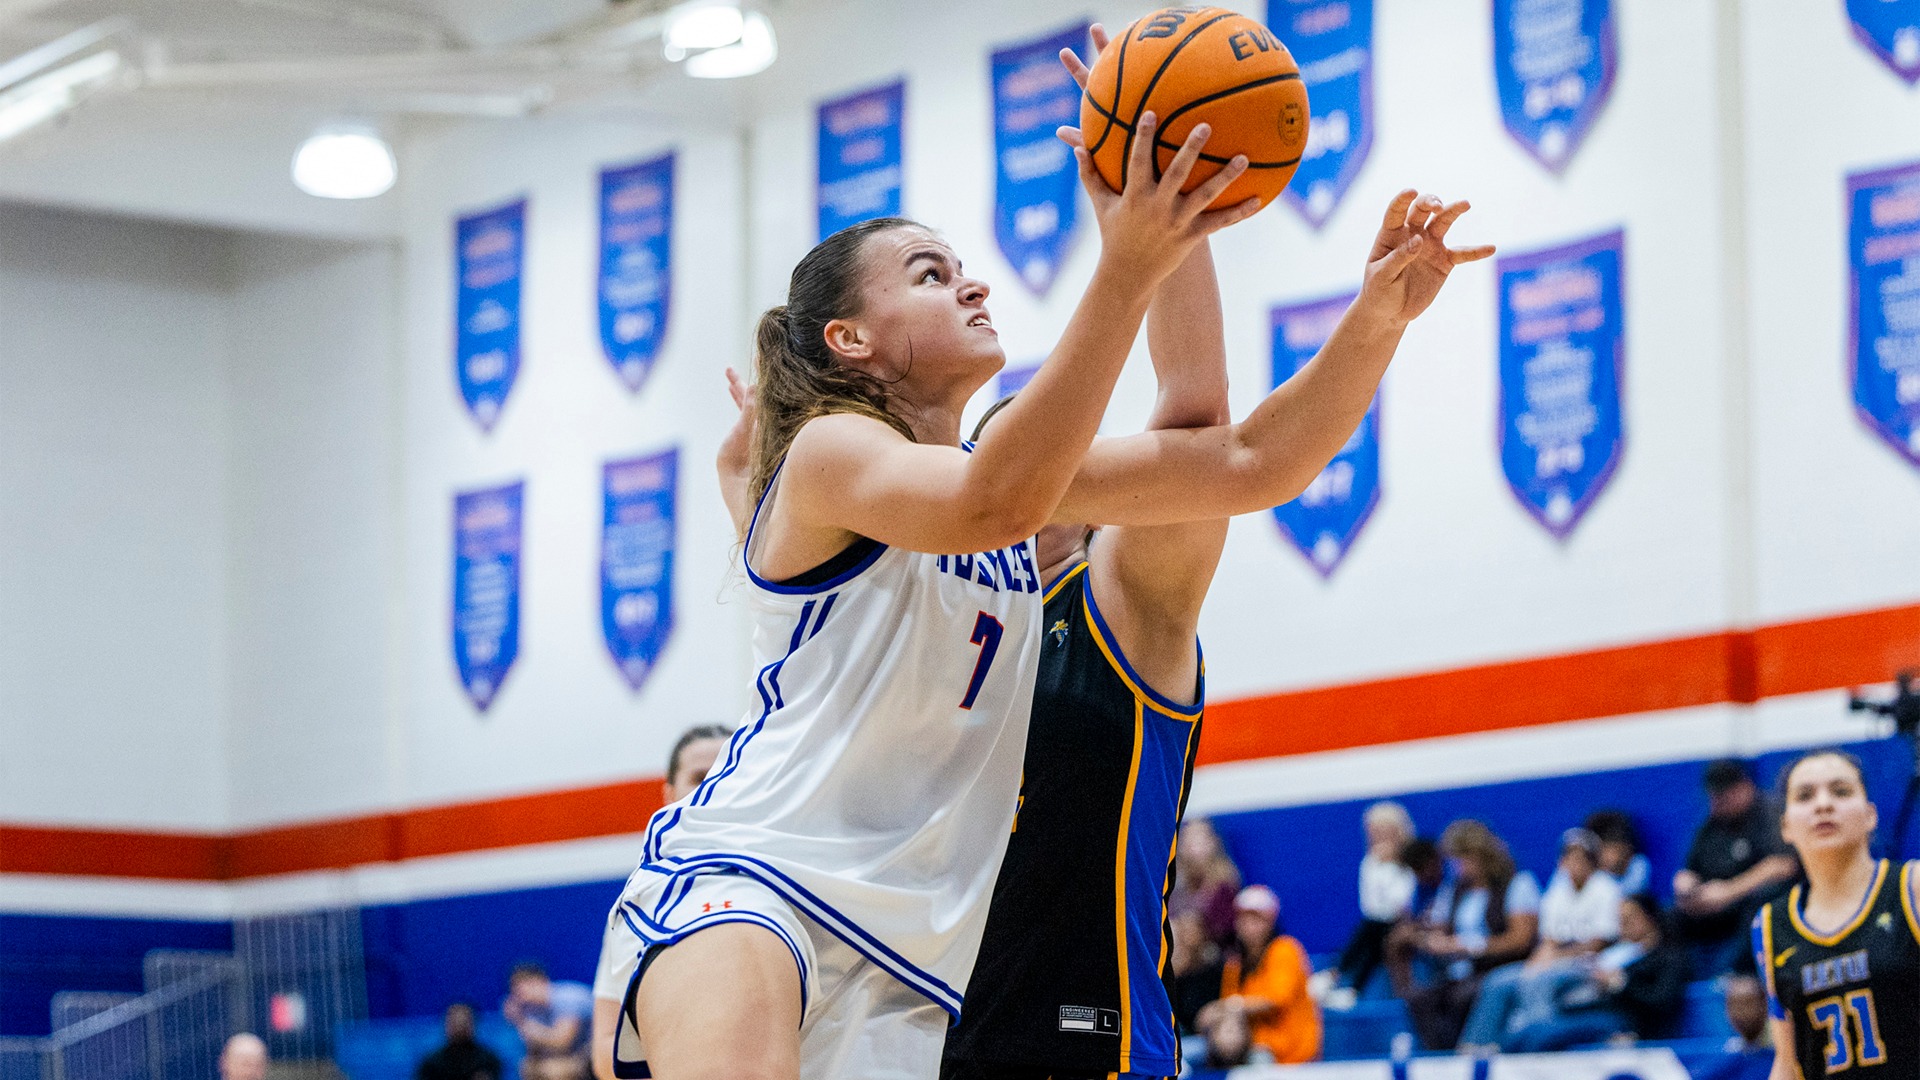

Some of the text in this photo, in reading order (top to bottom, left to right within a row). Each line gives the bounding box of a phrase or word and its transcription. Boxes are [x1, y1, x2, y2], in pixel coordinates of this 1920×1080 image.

[958, 610, 1004, 710] 7
[1104, 1015, 1111, 1027] L
[1806, 988, 1887, 1075] 31
